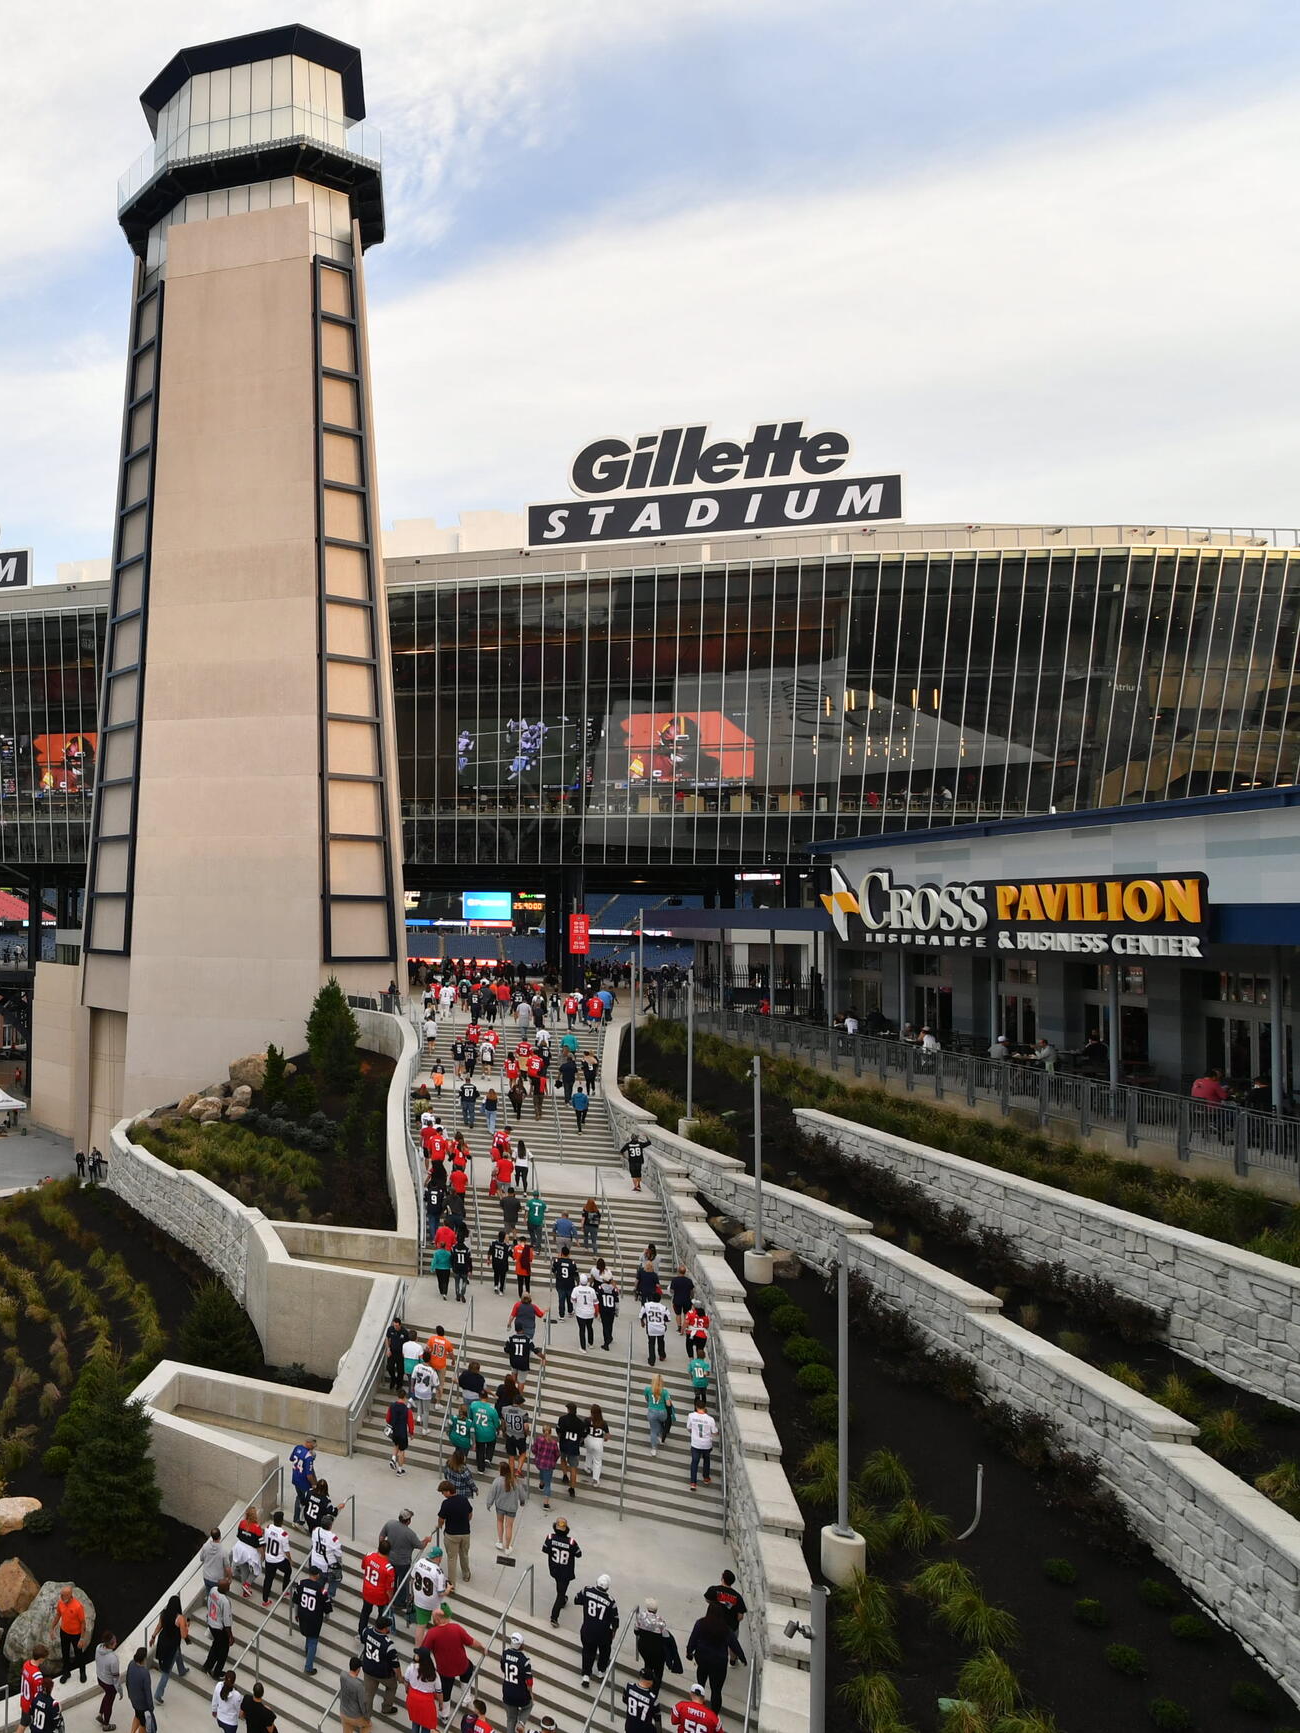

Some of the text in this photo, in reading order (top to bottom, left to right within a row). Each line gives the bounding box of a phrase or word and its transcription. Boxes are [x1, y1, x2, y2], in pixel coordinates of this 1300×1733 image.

[572, 421, 850, 494] Gillette
[543, 483, 884, 539] STADIUM
[858, 872, 1202, 932] CROSS PAVILION
[865, 933, 988, 948] INSURANCE
[997, 931, 1204, 958] & BUSINESS CENTER
[464, 1088, 474, 1097] 87
[434, 1142, 441, 1151] 9
[629, 1147, 641, 1157] 38
[430, 1194, 438, 1205] 9
[457, 1253, 465, 1264] 11
[494, 1248, 504, 1260] 19
[561, 1267, 569, 1279] 9
[583, 1294, 588, 1305] 1
[601, 1294, 614, 1308] 10
[647, 1311, 662, 1323] 25
[693, 1317, 704, 1328] 13
[431, 1343, 445, 1358] 13
[514, 1343, 524, 1357] 11
[416, 1371, 431, 1388] 54
[694, 1367, 704, 1378] 10
[474, 1413, 489, 1427] 72
[505, 1414, 523, 1431] 48
[455, 1423, 467, 1436] 13
[697, 1423, 704, 1439] 1
[292, 1455, 304, 1474] 24
[305, 1501, 320, 1520] 12
[266, 1536, 280, 1557] 10
[551, 1547, 570, 1565] 38
[365, 1566, 380, 1587] 12
[300, 1594, 316, 1612] 90
[587, 1599, 607, 1620] 87
[365, 1642, 380, 1664] 54
[504, 1661, 519, 1685] 12
[627, 1696, 650, 1721] 87
[687, 1706, 706, 1719] TIPPETT
[33, 1707, 46, 1730] 10
[683, 1718, 708, 1733] 56
